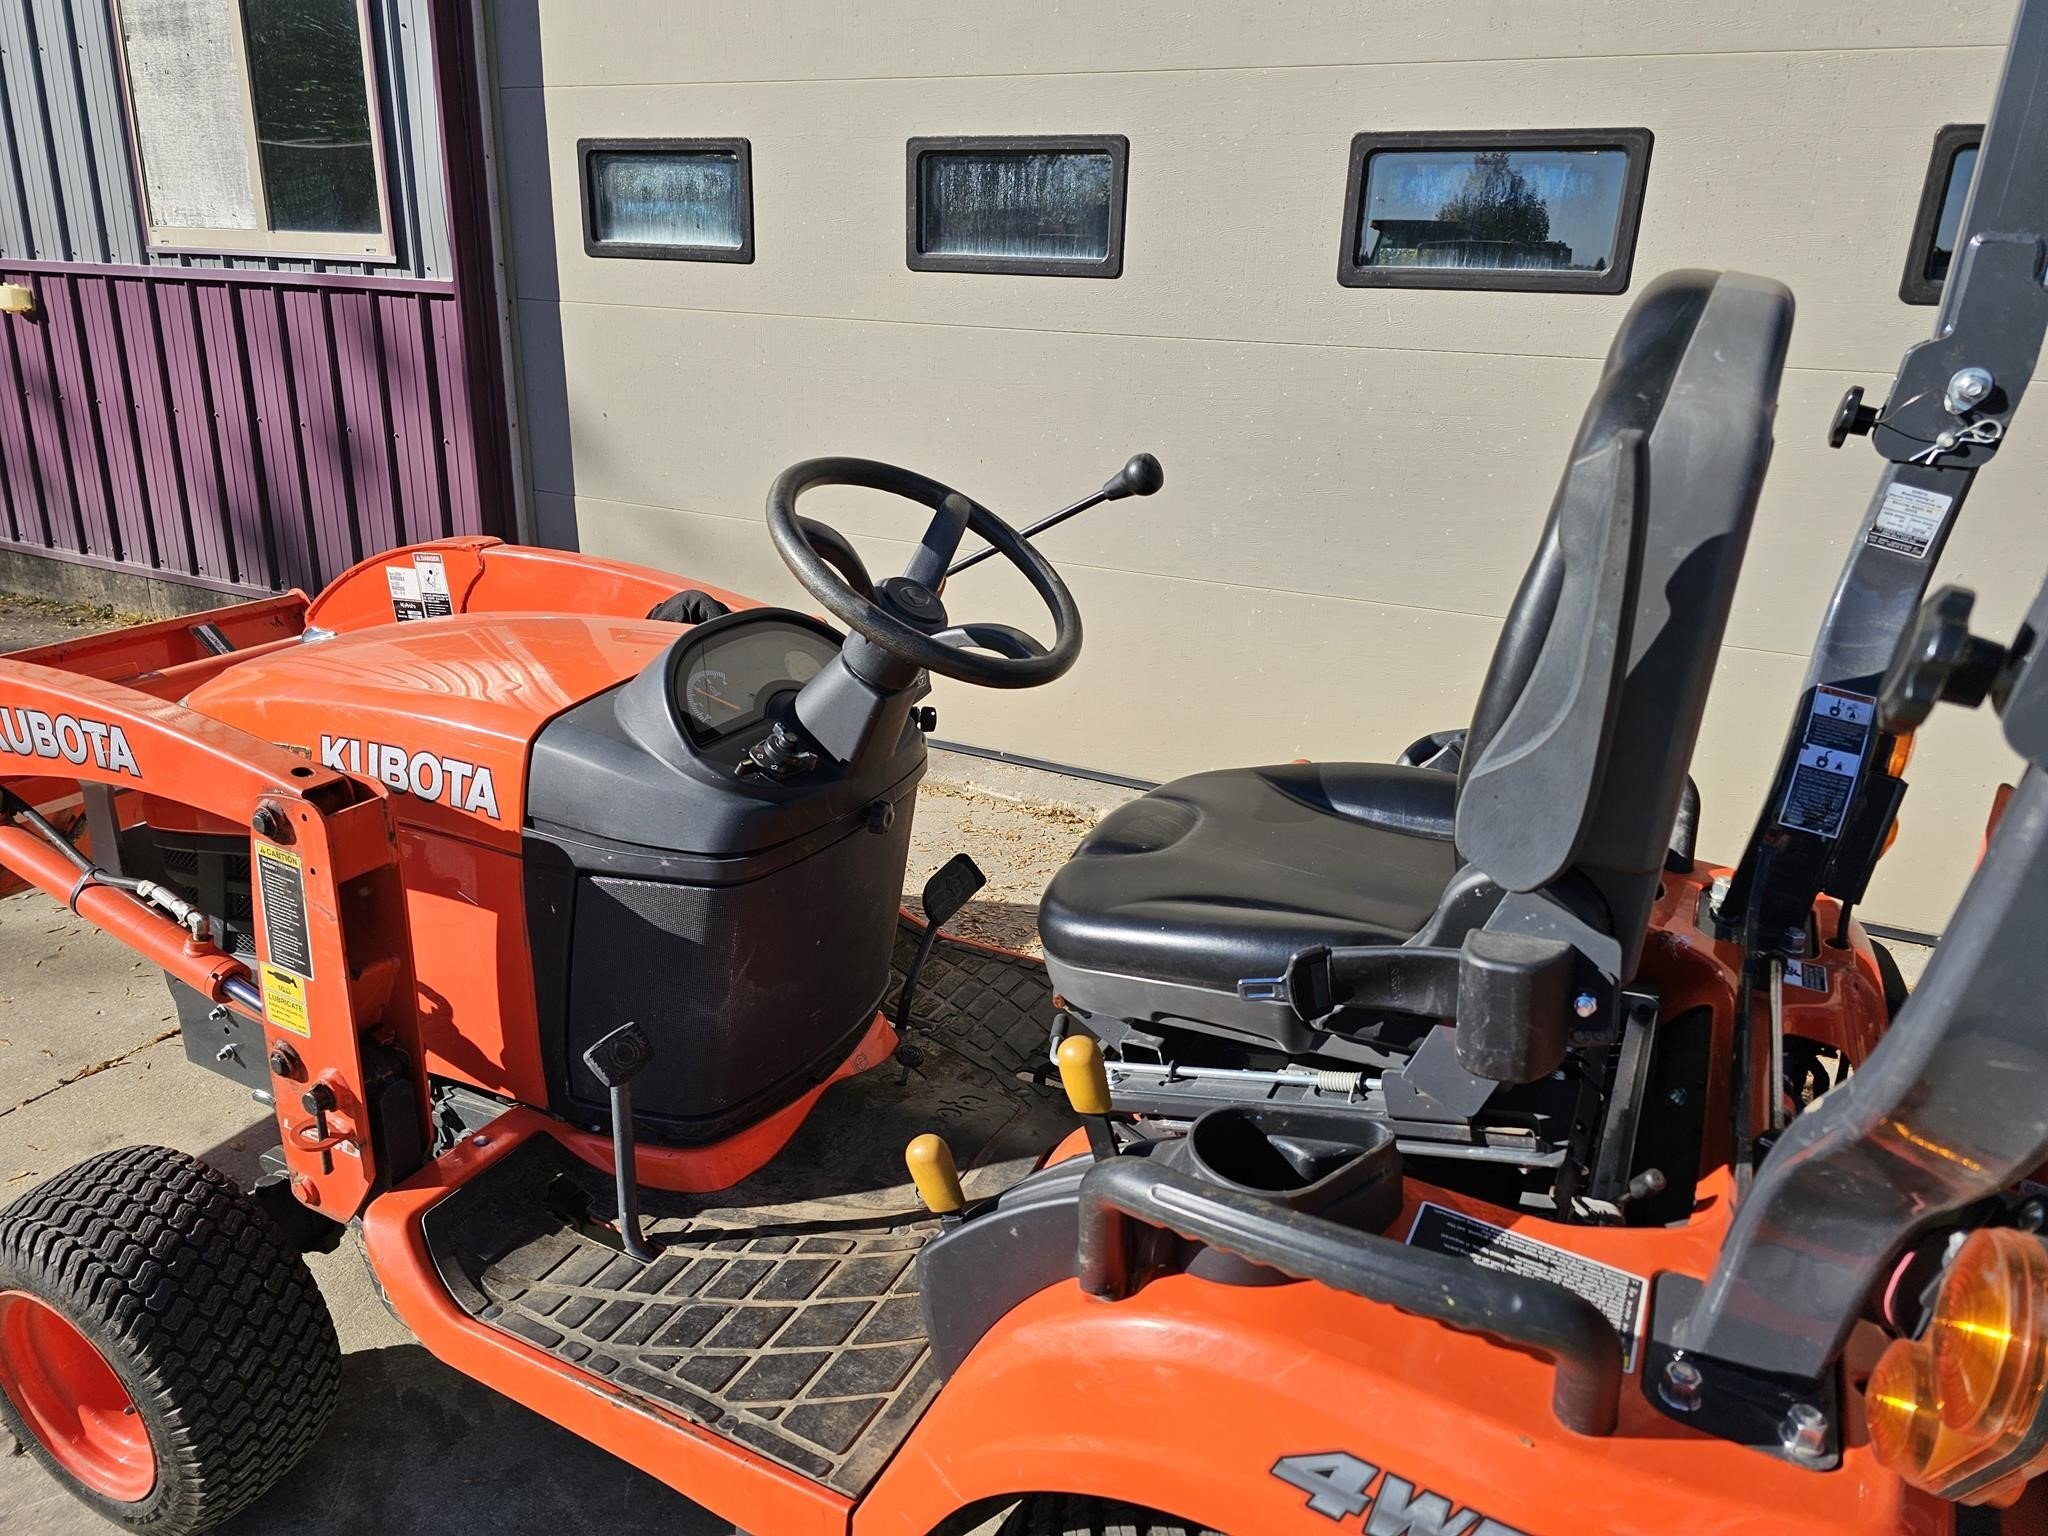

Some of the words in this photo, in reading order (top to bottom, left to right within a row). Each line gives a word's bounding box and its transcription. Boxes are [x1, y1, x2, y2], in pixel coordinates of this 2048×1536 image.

[320, 734, 501, 820] KUBOTA
[266, 848, 299, 866] CAUTION
[268, 992, 304, 1013] LUBRICATE
[1269, 1450, 1532, 1536] 4W
